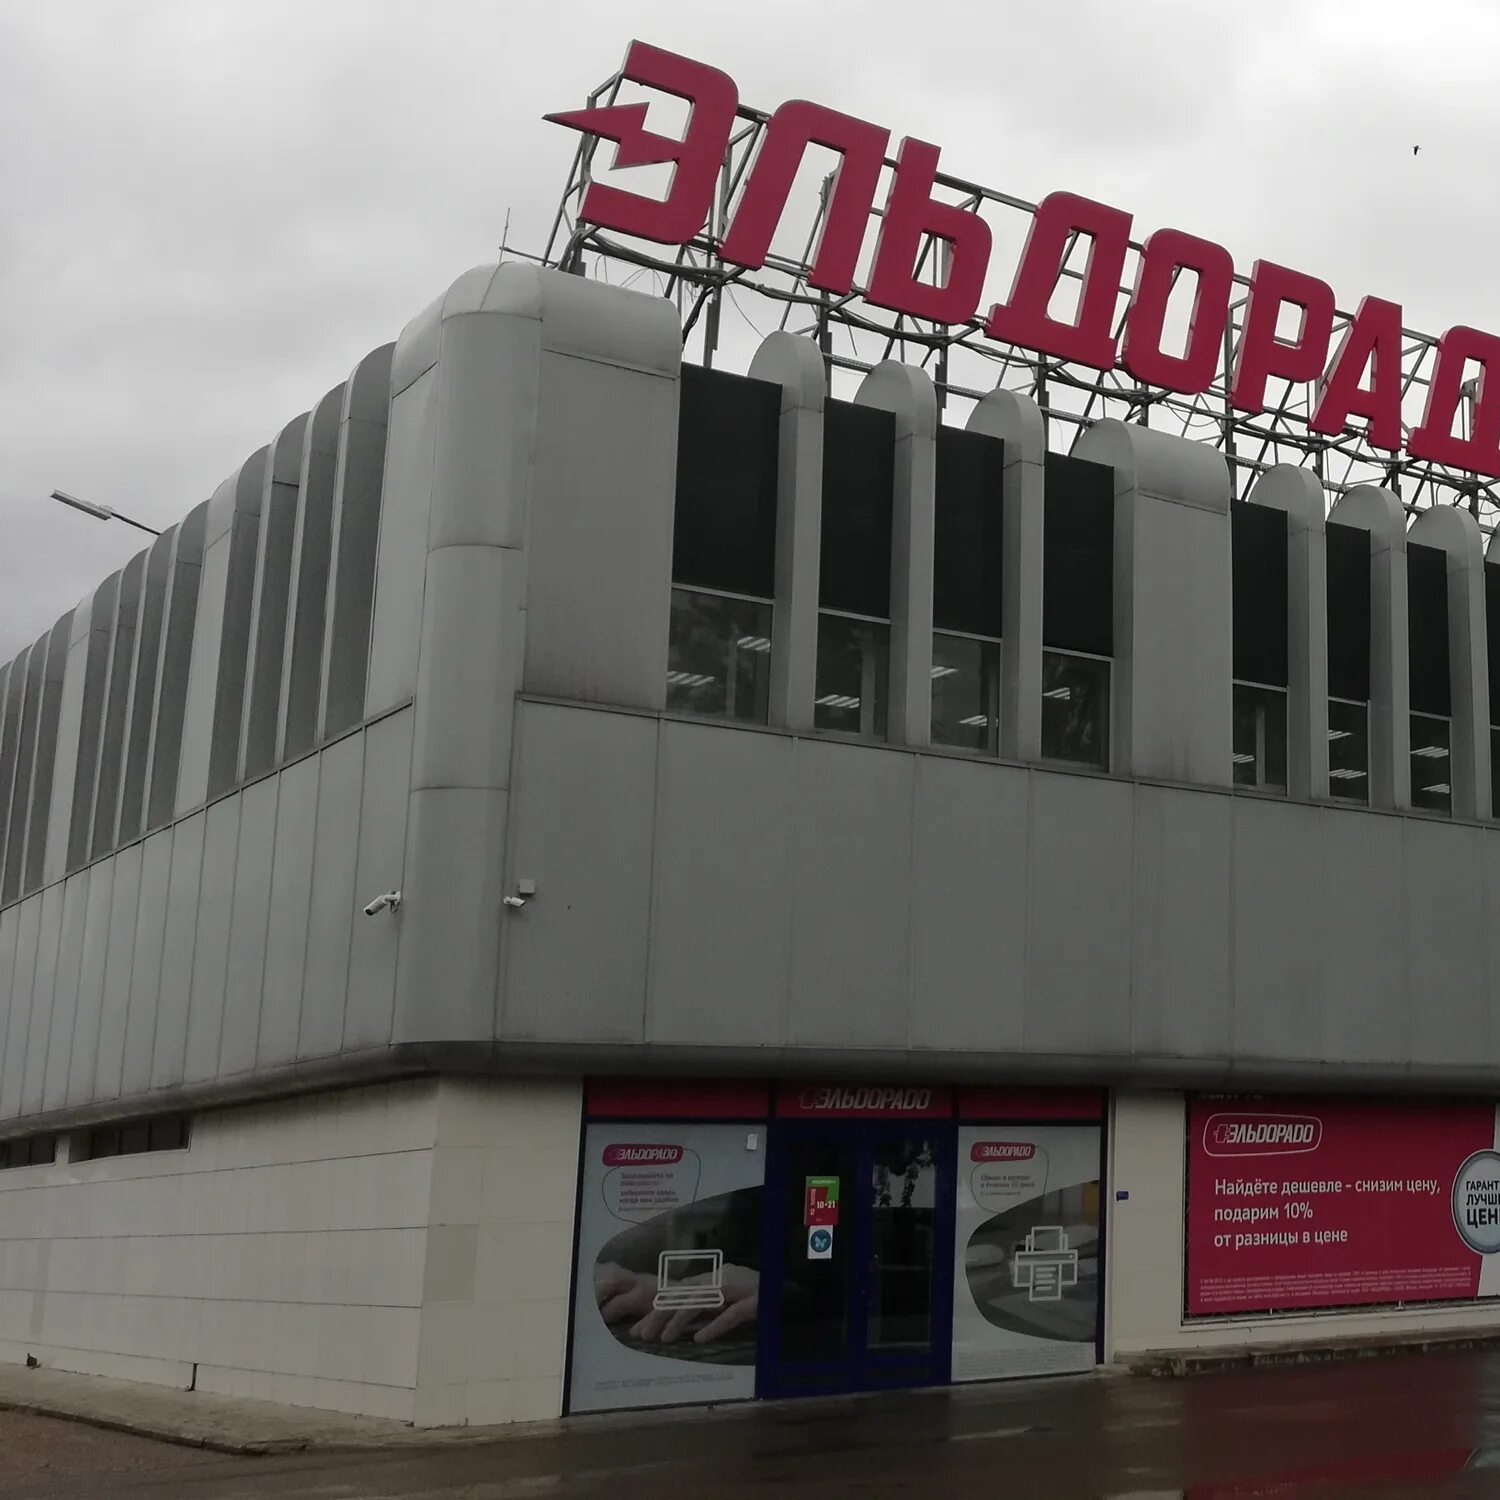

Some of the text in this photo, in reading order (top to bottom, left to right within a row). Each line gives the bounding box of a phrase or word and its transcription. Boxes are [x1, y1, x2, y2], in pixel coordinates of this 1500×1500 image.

[1215, 1178, 1278, 1197] Найдёте
[1281, 1180, 1343, 1196] дешевле
[1355, 1180, 1403, 1193] снизим
[1406, 1179, 1440, 1196] цену,
[1214, 1200, 1313, 1224] подарим 10%
[1214, 1229, 1348, 1251] от разницы в цене
